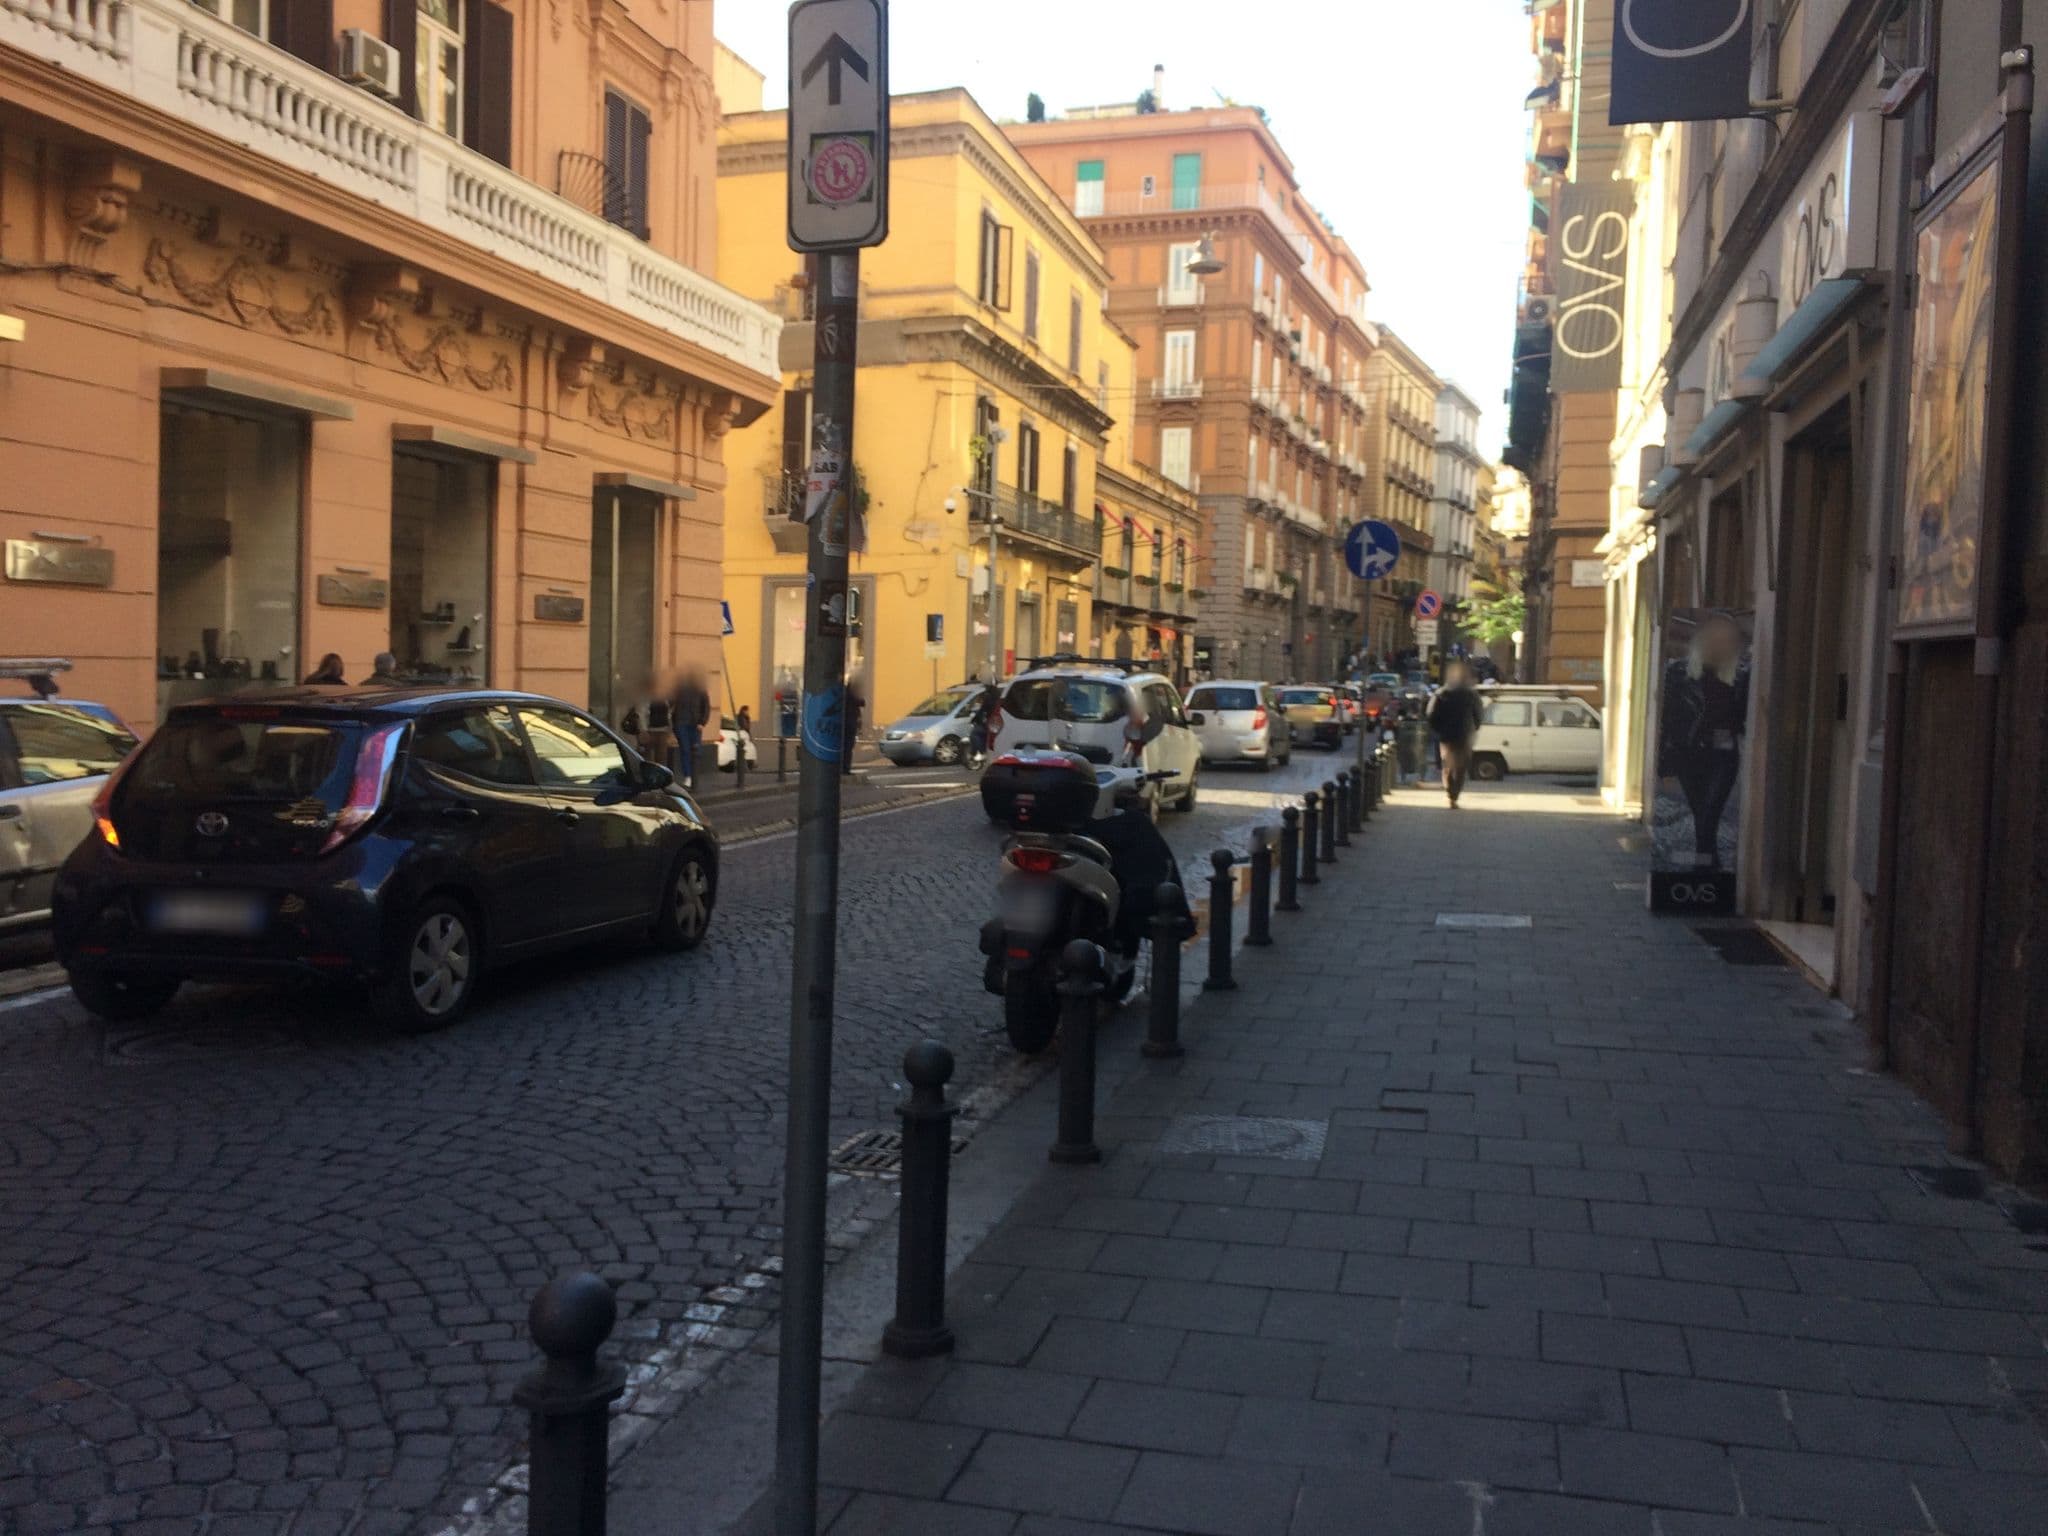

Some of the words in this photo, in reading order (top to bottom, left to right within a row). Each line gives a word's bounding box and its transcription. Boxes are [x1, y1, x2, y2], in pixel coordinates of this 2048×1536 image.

[1557, 211, 1628, 359] OVS
[1793, 171, 1837, 309] OVS
[1671, 883, 1717, 903] OVS
